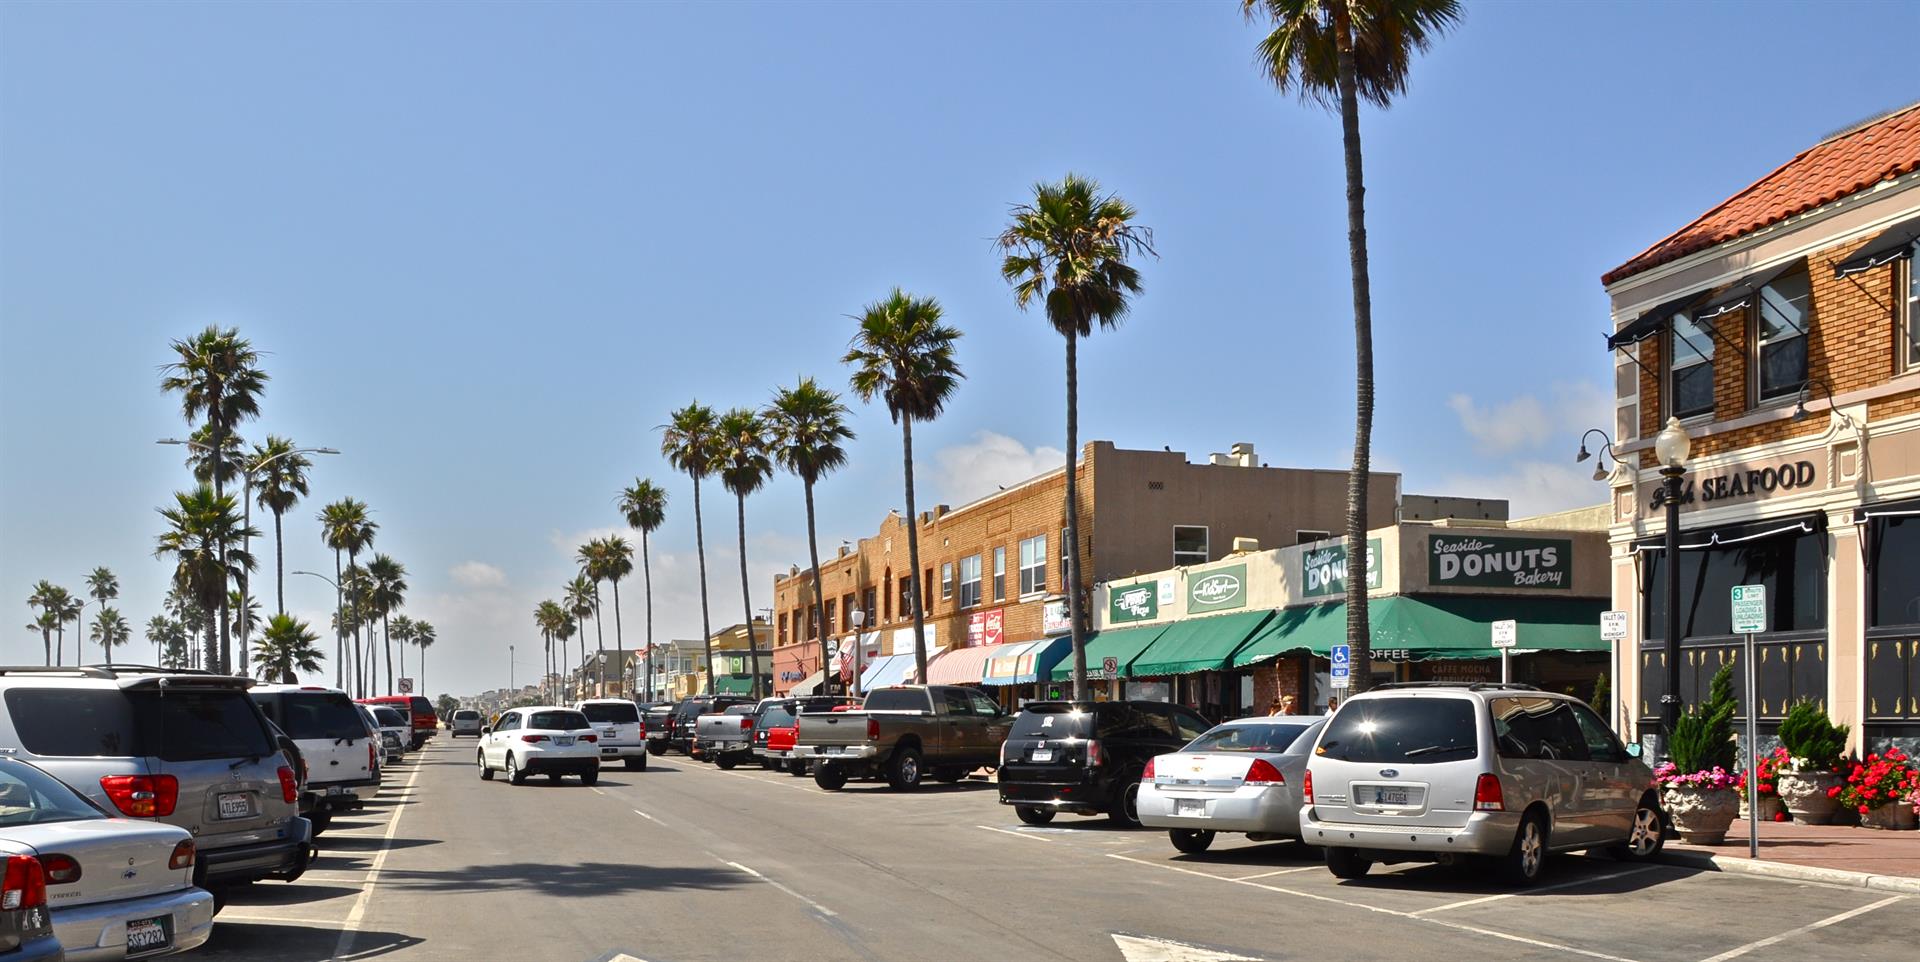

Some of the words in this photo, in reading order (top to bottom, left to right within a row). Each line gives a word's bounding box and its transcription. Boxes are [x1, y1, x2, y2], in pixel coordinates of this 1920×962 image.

[1702, 461, 1815, 501] SEAFOOD
[1434, 539, 1495, 554] Seaside
[1305, 550, 1338, 571] Seaside
[1308, 548, 1375, 590] DONUS
[1440, 547, 1558, 580] DONUTS
[1514, 569, 1563, 586] Bakery
[1734, 588, 1741, 600] 3
[1369, 649, 1410, 660] OFFEE
[1431, 664, 1458, 674] CAFFE
[1461, 664, 1491, 674] MOCHA
